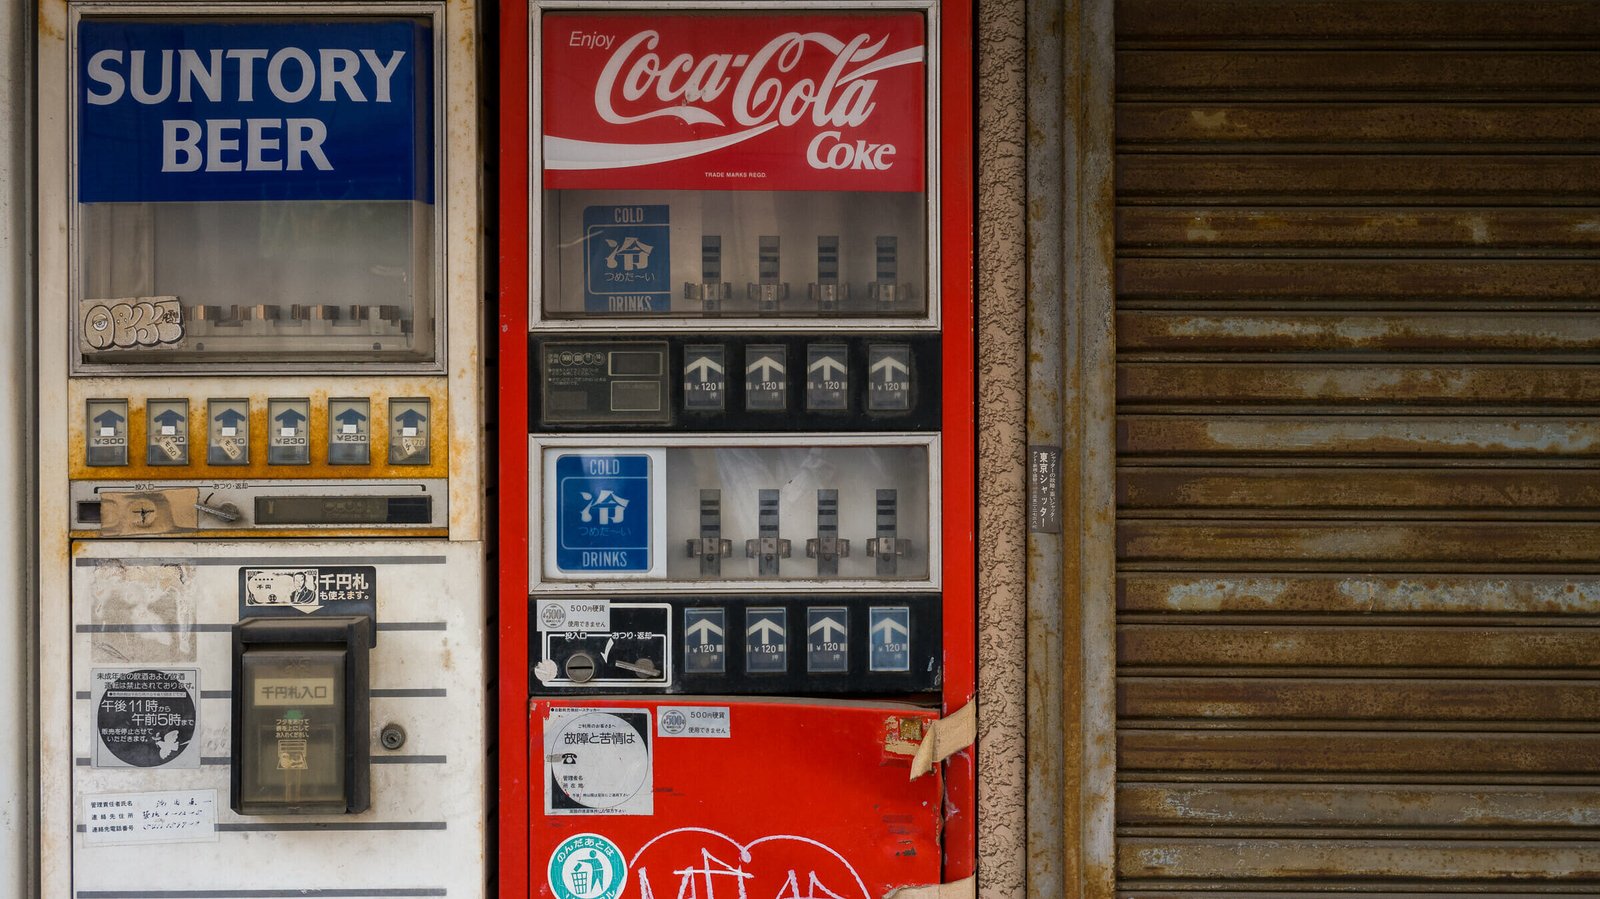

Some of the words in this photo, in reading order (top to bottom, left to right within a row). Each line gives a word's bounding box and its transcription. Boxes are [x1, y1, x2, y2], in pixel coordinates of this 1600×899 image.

[569, 31, 615, 49] Enjoy
[87, 46, 406, 106] SUNTORY
[594, 29, 890, 129] Coca-Cola
[161, 118, 335, 173] BEER
[805, 130, 897, 171] Coke
[614, 207, 644, 223] COLD
[604, 237, 654, 271] 冷
[608, 295, 653, 313] DRINKS
[94, 437, 126, 446] ¥300
[275, 437, 306, 446] ¥230
[336, 434, 367, 442] ¥230
[589, 458, 620, 476] COLD
[1039, 452, 1049, 528] 東京シャッター
[580, 489, 630, 525] 冷
[582, 551, 628, 568] DRINKS
[319, 573, 369, 591] 千円札
[319, 591, 370, 601] も使えます。
[570, 604, 605, 613] 500円硬貨
[568, 620, 606, 628] 使用できません
[565, 632, 588, 640] 投入口
[611, 631, 653, 640] おつり・返却
[261, 685, 327, 700] 千円札入口
[101, 699, 172, 713] 午後11時から
[131, 713, 195, 727] 午前5時まで
[690, 711, 725, 719] 500円硬貨
[564, 732, 636, 745] 故障と苦情は
[557, 838, 615, 863] のんだあとは
